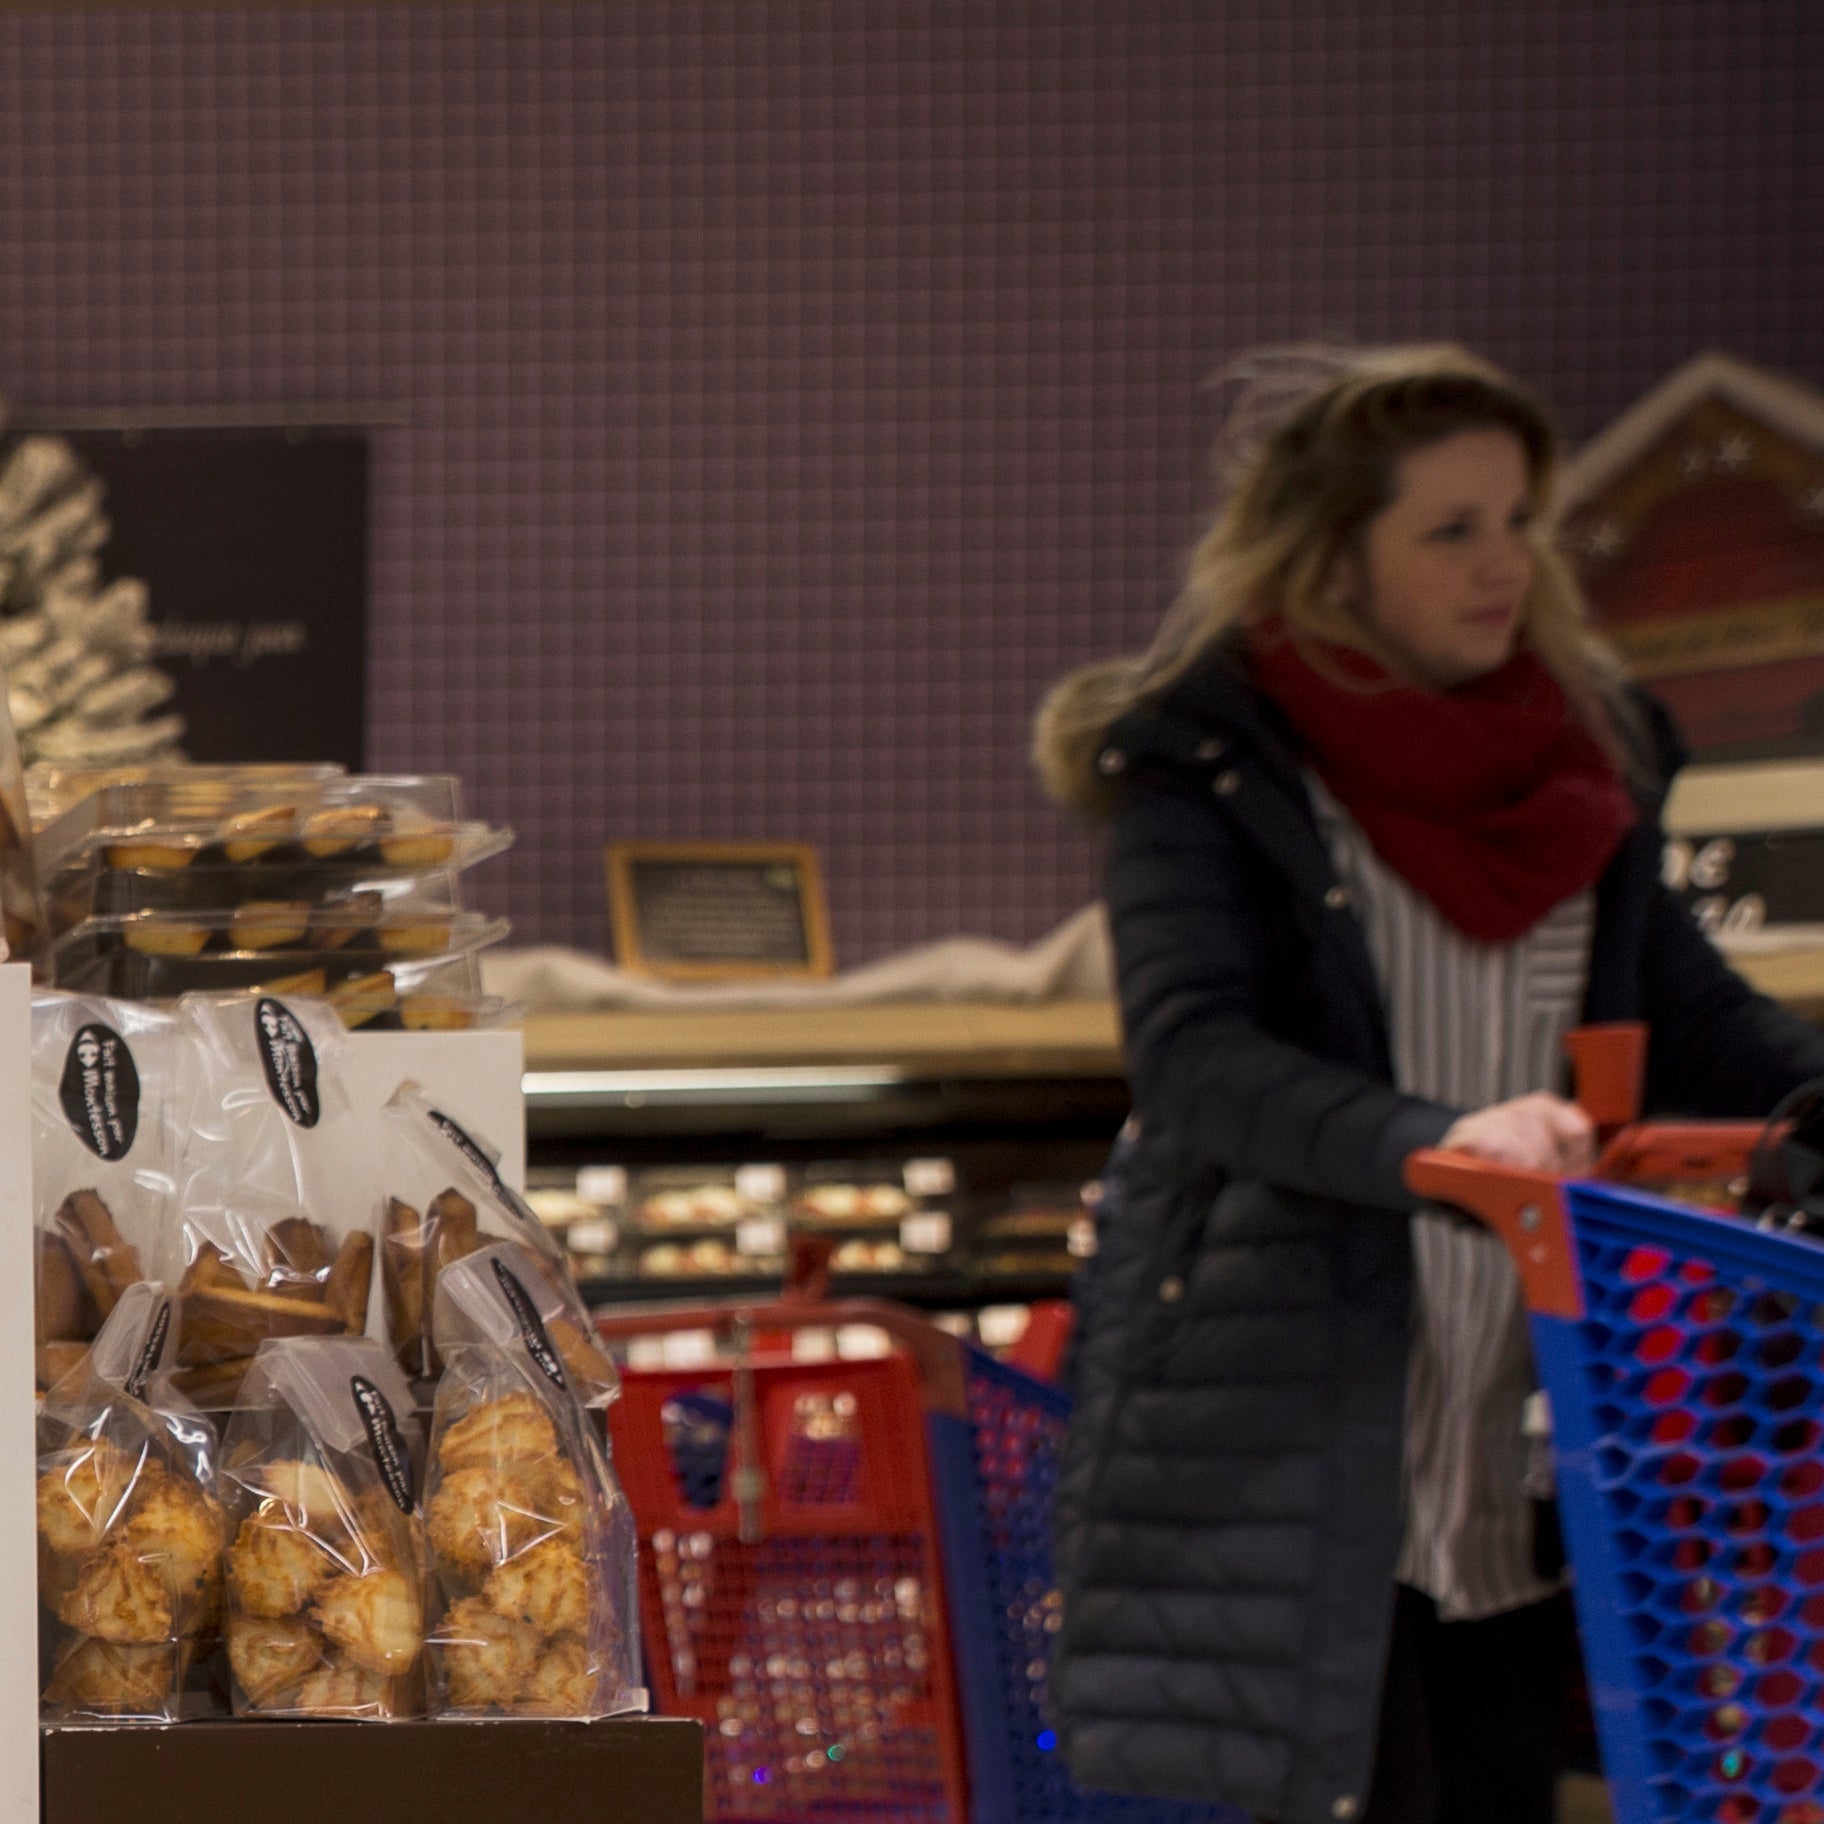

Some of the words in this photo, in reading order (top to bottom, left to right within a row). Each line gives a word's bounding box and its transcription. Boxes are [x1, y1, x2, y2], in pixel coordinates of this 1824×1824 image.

[102, 1040, 116, 1067] Fait
[104, 1069, 118, 1117] maison
[82, 1068, 110, 1157] Montesson
[106, 1118, 123, 1144] par
